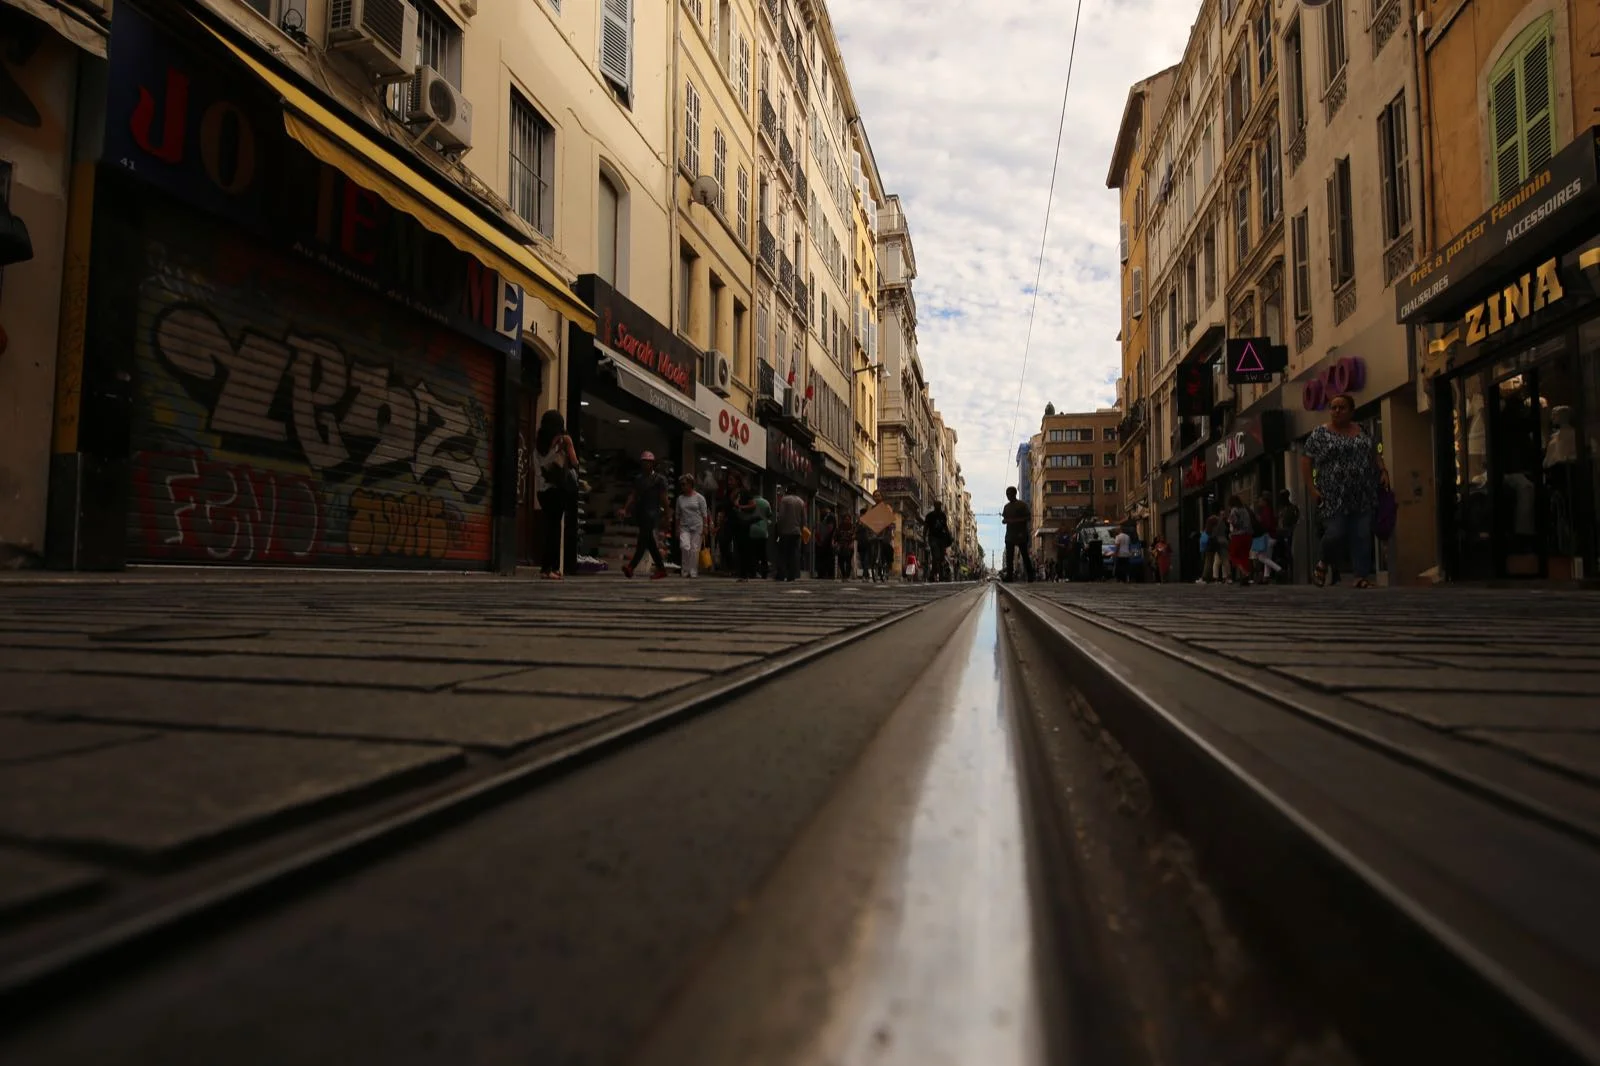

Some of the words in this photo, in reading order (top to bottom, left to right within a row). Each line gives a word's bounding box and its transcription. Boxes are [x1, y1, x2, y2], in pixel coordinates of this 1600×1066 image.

[120, 157, 136, 171] 41
[129, 63, 378, 266] JOIE
[1504, 177, 1582, 245] ACCESSOIRES
[1446, 220, 1487, 264] porter
[1401, 274, 1449, 319] CHAUSSURES
[1465, 256, 1565, 347] ZINA
[530, 320, 538, 337] 41
[614, 322, 655, 368] Sarah
[658, 351, 690, 389] Mode
[649, 389, 671, 413] Sarah
[1303, 356, 1366, 412] OXO
[719, 408, 750, 445] OXO
